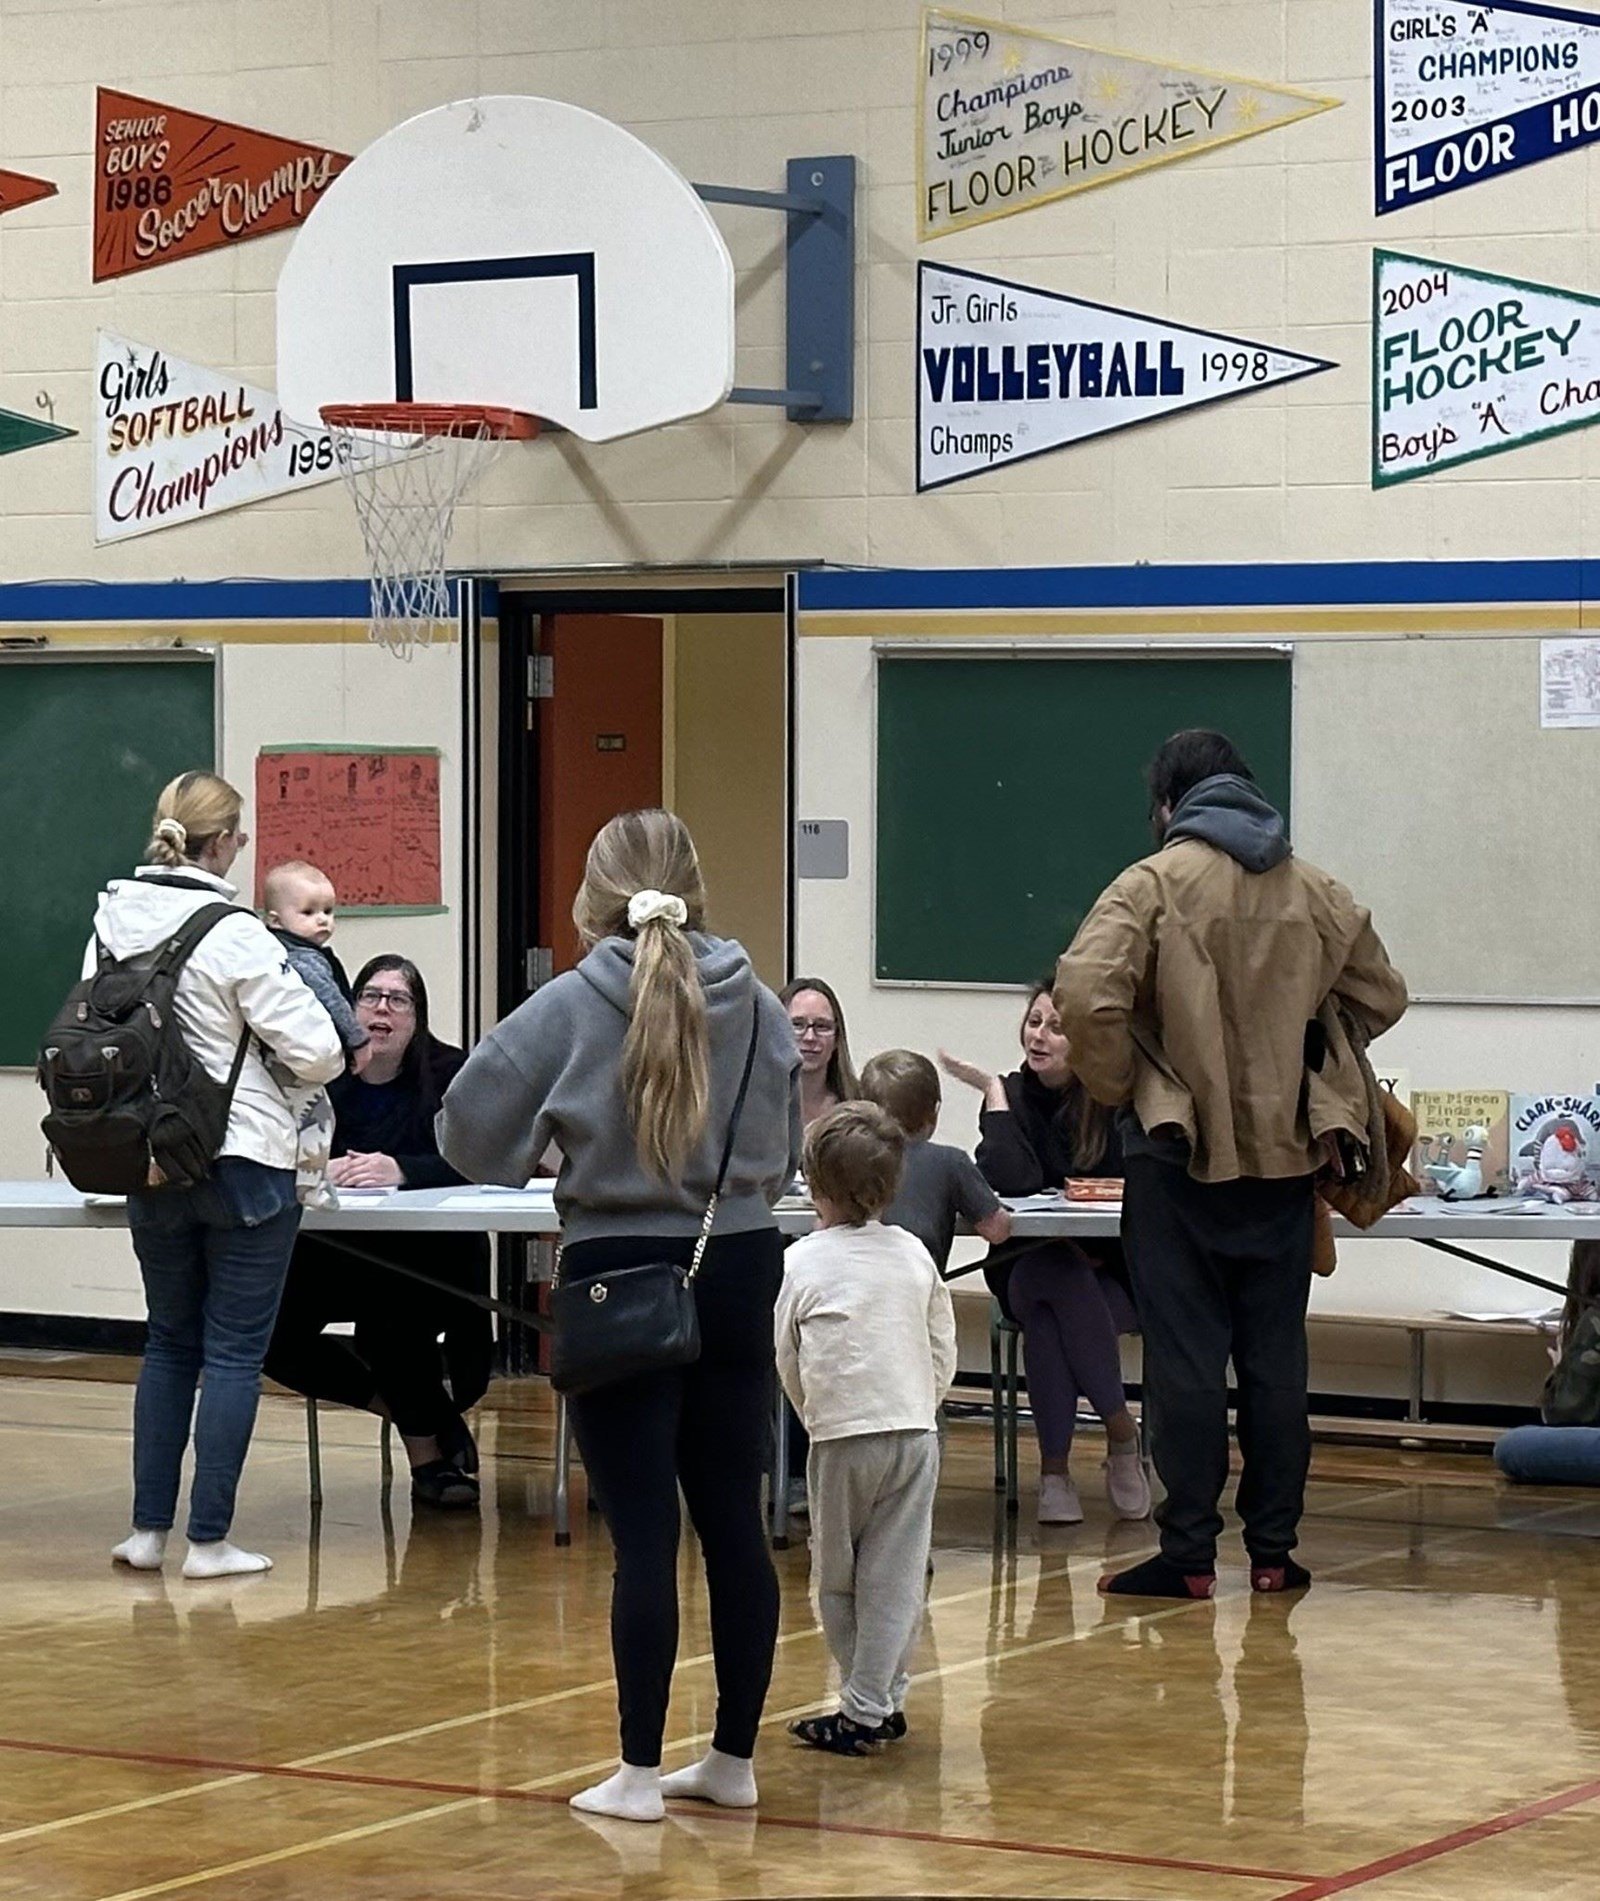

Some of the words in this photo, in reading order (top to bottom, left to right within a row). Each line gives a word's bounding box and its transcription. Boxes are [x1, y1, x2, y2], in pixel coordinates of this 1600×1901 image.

[1390, 13, 1457, 42] GIRL'S
[1467, 7, 1494, 34] "A"
[928, 31, 991, 77] 1999
[1418, 41, 1579, 82] CHAMPIONS
[937, 66, 1073, 122] Champions
[1391, 95, 1466, 122] 2003
[104, 114, 168, 145] SENIOR
[937, 125, 1012, 160] Junior
[1024, 101, 1083, 134] Boys
[105, 140, 170, 176] BOYS
[928, 155, 1036, 222] FLOOR
[1064, 88, 1228, 176] HOCKEY
[1385, 123, 1515, 202] FLOOR
[105, 174, 174, 213] 1986
[134, 177, 225, 259] Soccer
[220, 152, 342, 238] Champs
[931, 295, 961, 324] Jr.
[966, 293, 1018, 324] Girls
[1382, 271, 1449, 316] 2004
[1383, 299, 1529, 372] FLOOR
[99, 350, 169, 418] Girls
[922, 340, 1184, 403] VOLLEYBALL
[1201, 351, 1269, 383] 1998
[1383, 318, 1582, 413] HOCKEY
[108, 386, 255, 457] SOFTBALL
[930, 425, 1014, 463] Champs
[1381, 422, 1459, 463] Boy's
[1472, 394, 1511, 435] "A"
[108, 410, 284, 523] Champions
[803, 823, 821, 835] 116
[1414, 1093, 1442, 1104] The
[1446, 1093, 1500, 1106] Pigeon
[1427, 1104, 1472, 1116] Finds
[1515, 1097, 1556, 1132] CLARK
